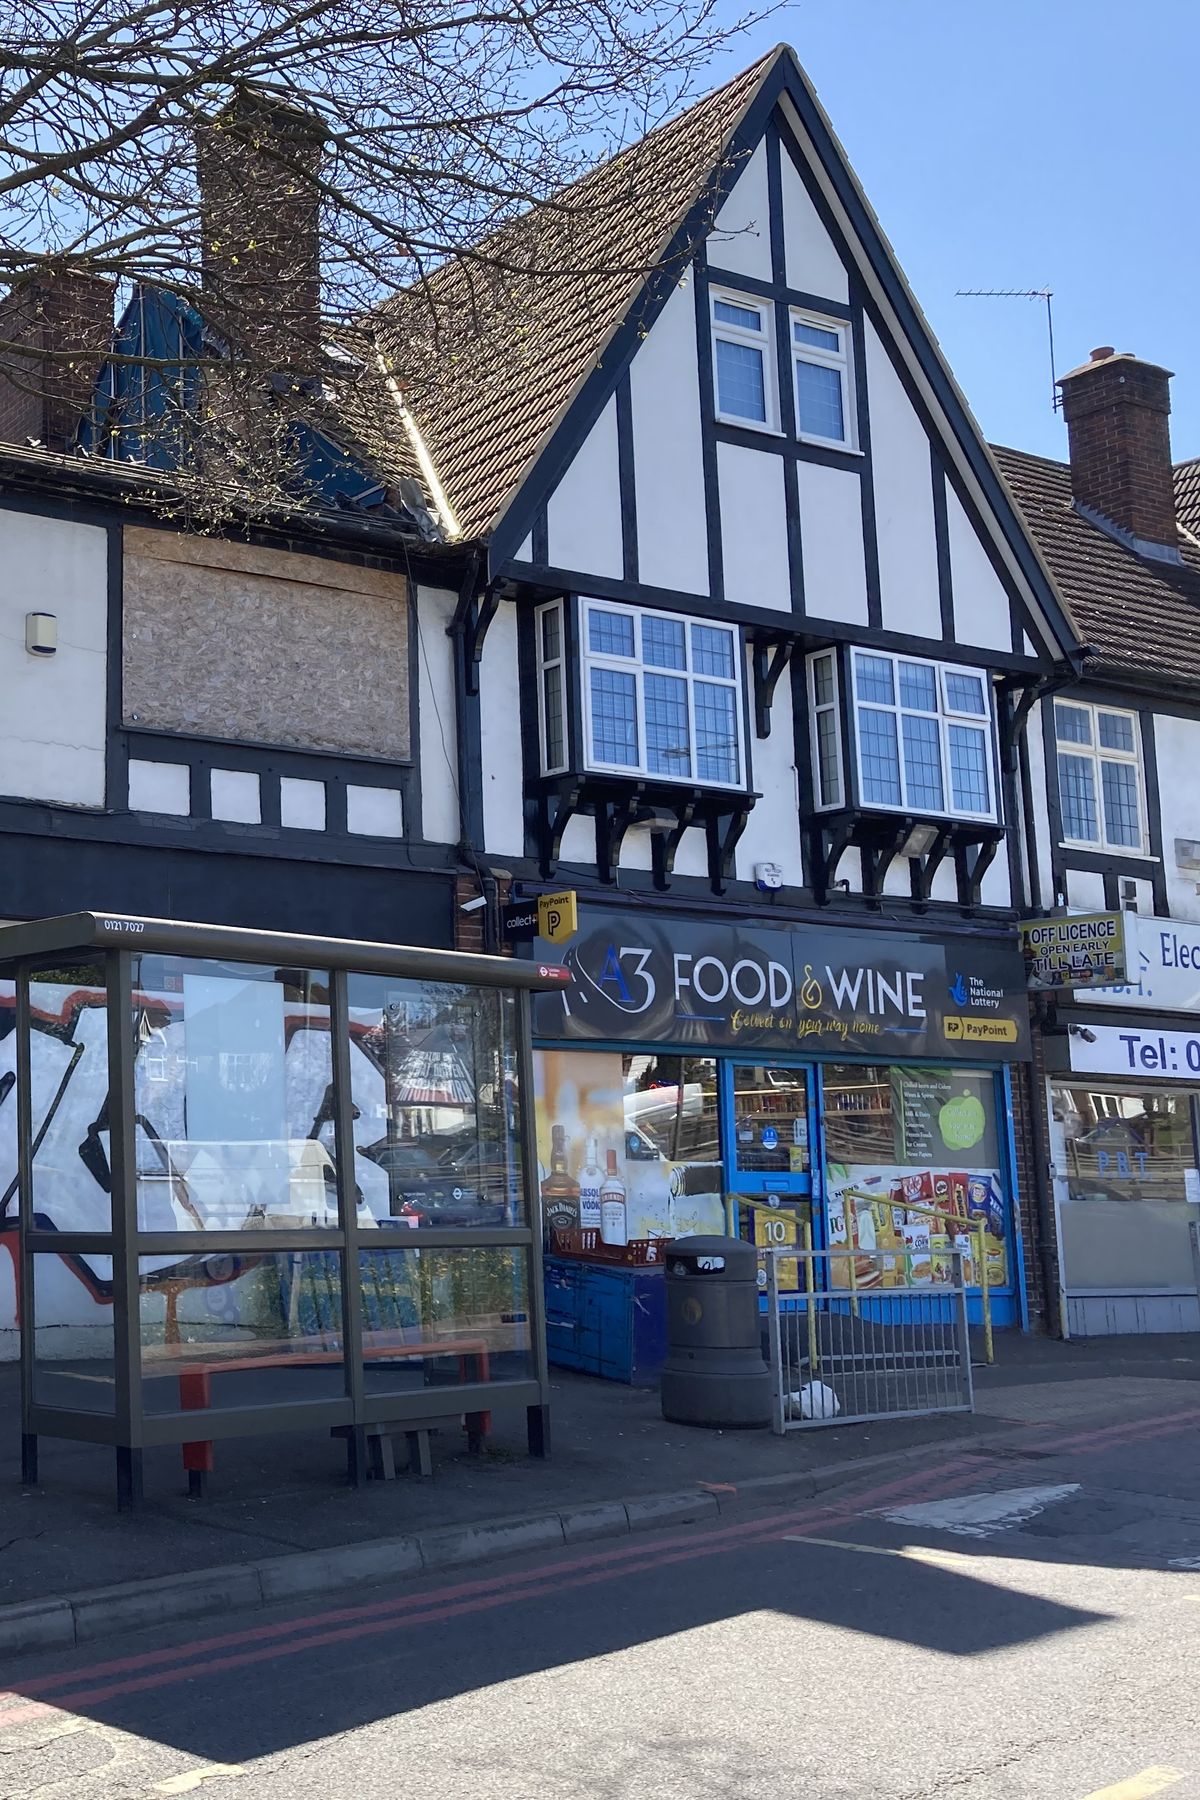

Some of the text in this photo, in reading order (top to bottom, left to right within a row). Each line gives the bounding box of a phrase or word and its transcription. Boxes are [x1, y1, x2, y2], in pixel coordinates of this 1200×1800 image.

[540, 896, 569, 908] PayPoint
[104, 920, 145, 933] 0121 7027
[1031, 920, 1116, 944] OFF LICENCE
[1040, 941, 1109, 956] OPEN EARLY
[1033, 952, 1115, 972] TILL LATE
[600, 944, 927, 1018] A3 FOOD & WINE
[969, 976, 984, 986] The
[970, 987, 1004, 998] National
[971, 997, 1000, 1009] Lottery
[731, 1009, 879, 1041] Collect on your way home
[967, 1024, 1008, 1036] PayPoint
[1119, 1034, 1178, 1070] Tel:
[764, 1221, 785, 1242] 10
